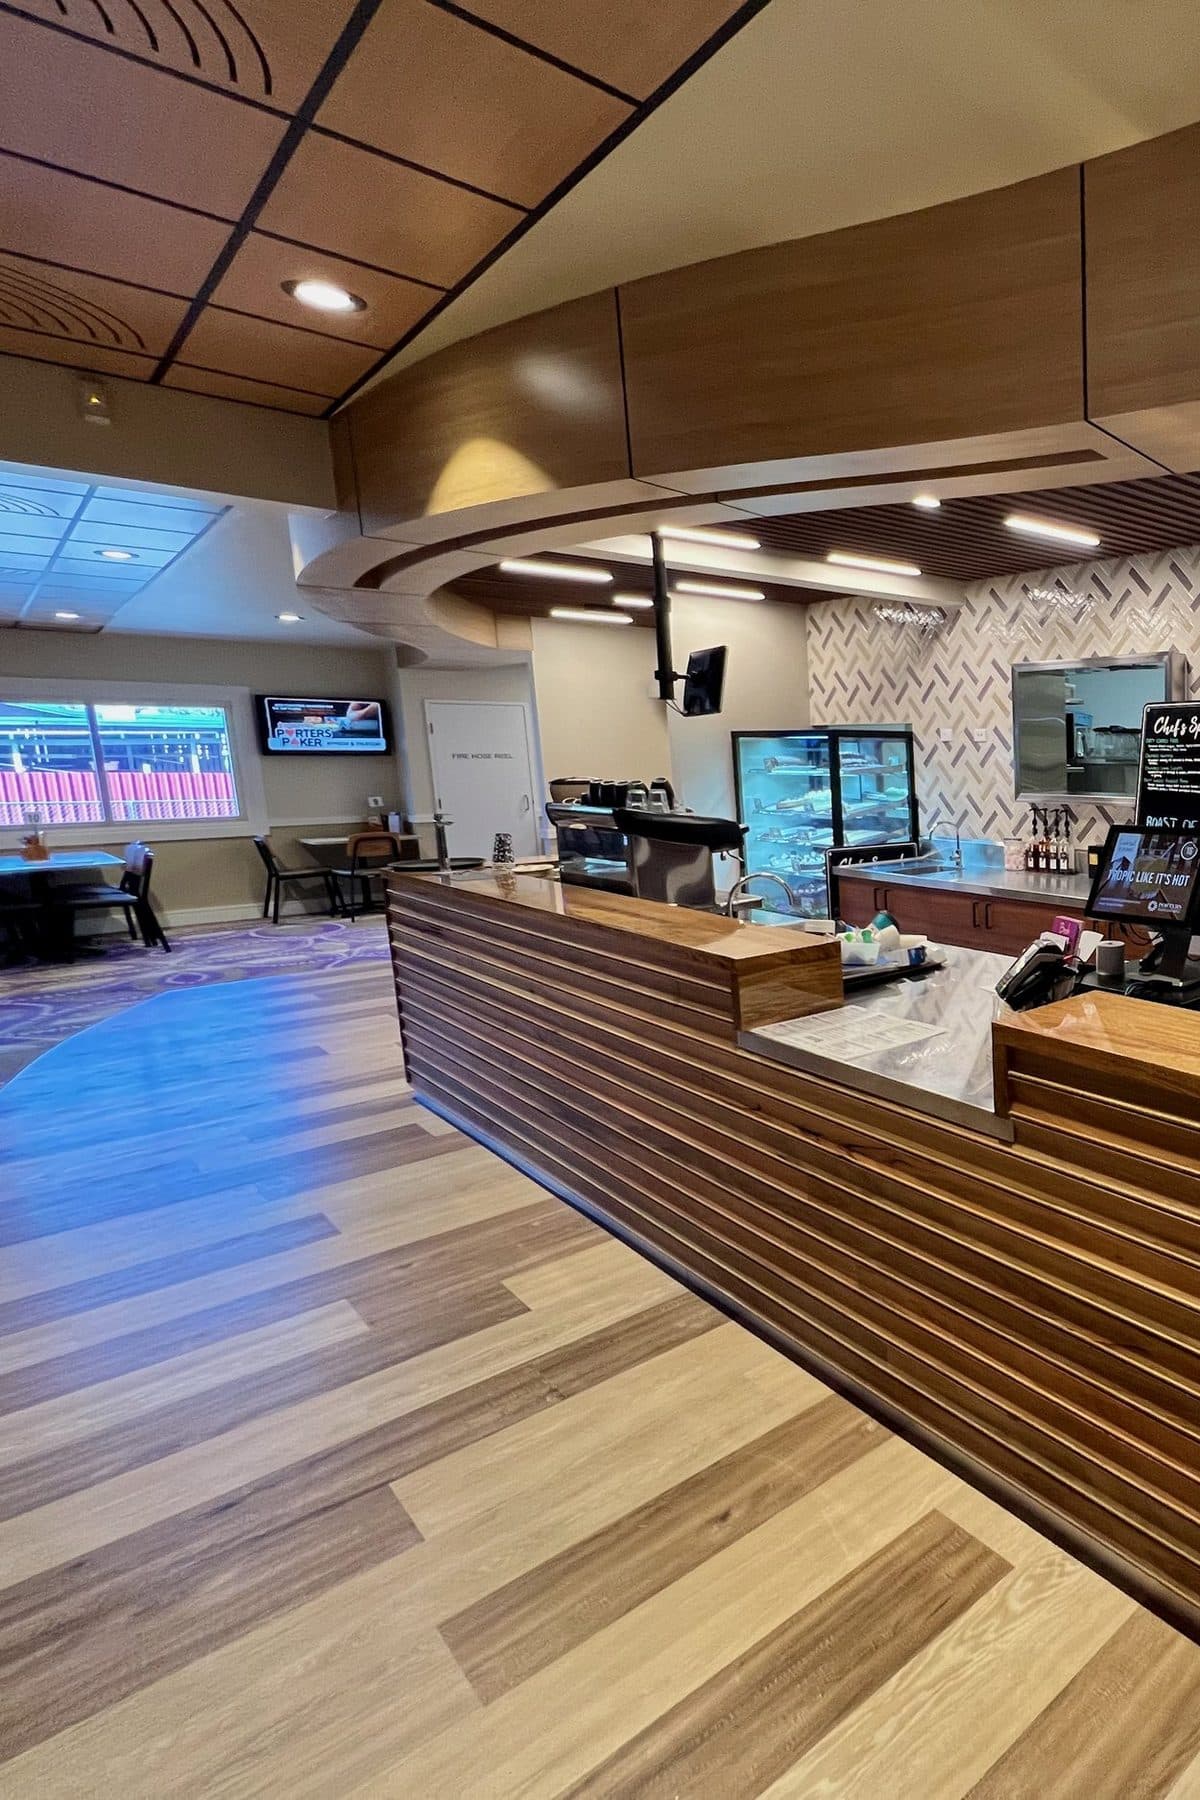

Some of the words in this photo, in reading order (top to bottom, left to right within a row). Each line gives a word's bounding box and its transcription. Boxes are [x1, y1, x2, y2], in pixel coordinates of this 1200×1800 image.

[277, 729, 332, 738] PRTERS
[283, 738, 321, 747] PKER
[1108, 869, 1135, 882] TROPIC
[1136, 872, 1154, 884] LIKE
[1155, 873, 1171, 886] IT'S
[1171, 875, 1190, 887] HOT
